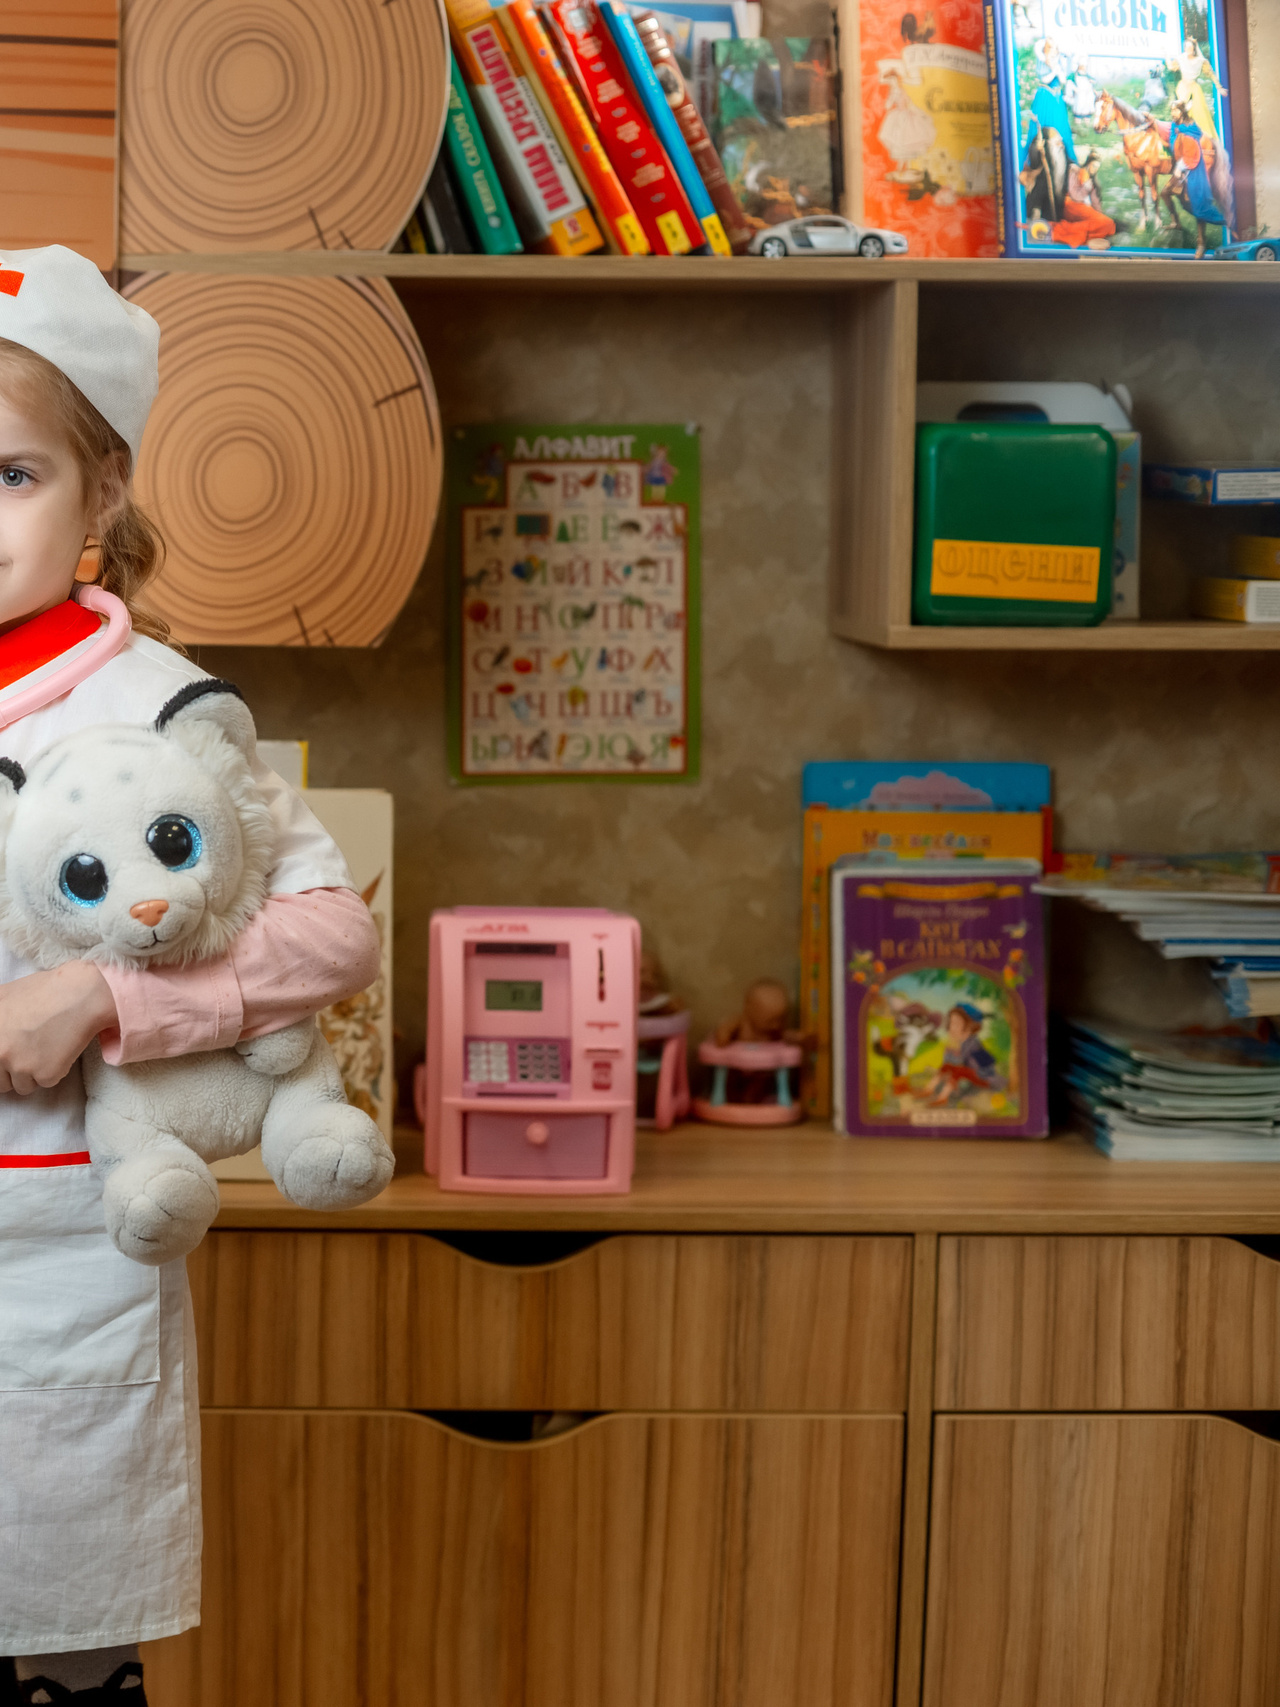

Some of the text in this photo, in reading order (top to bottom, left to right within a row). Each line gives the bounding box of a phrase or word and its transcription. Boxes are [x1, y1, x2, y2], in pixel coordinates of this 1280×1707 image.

[1054, 0, 1167, 33] сказки
[1074, 33, 1150, 47] МАЛЫШАМ
[471, 29, 539, 143] ХРЕСТОМАТИЯ
[452, 112, 481, 167] СКАЗОК
[513, 434, 637, 459] АЛФАВИТ
[919, 920, 960, 941] КОТ
